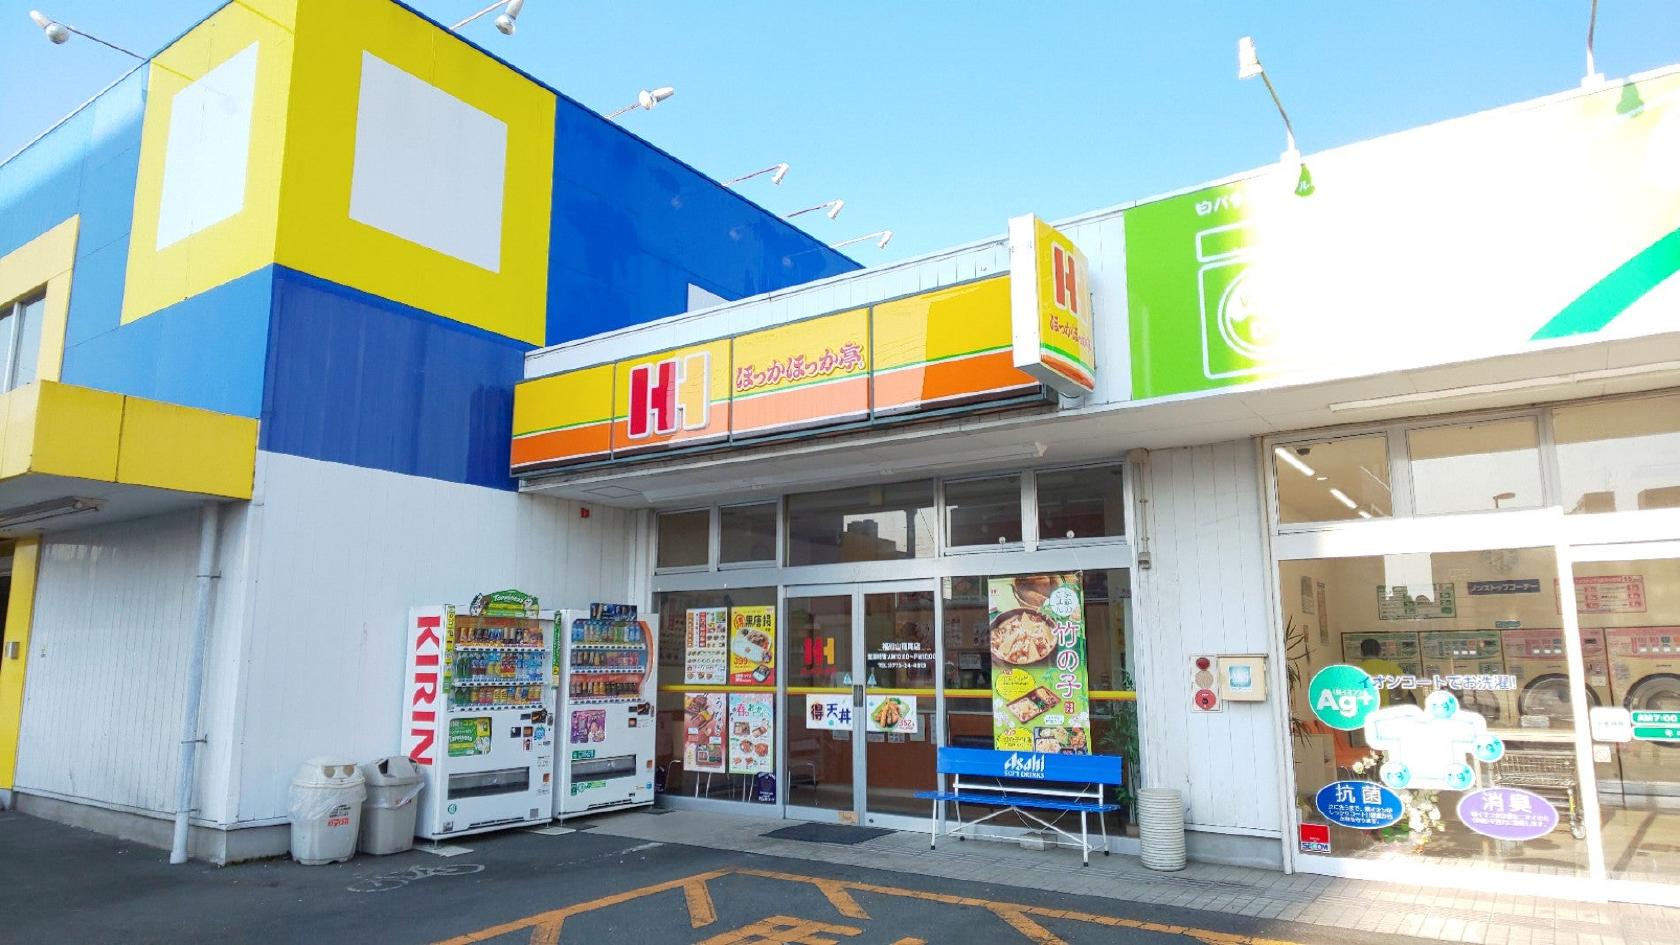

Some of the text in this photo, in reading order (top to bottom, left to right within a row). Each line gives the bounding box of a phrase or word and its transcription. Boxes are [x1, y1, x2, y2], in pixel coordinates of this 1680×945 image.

[736, 342, 866, 391] ほっかほっか亭
[1053, 621, 1082, 698] 竹の子
[410, 615, 441, 765] KIRIN
[1317, 689, 1374, 718] Ag+
[1004, 752, 1045, 772] Asahi
[1335, 783, 1383, 805] 抗菌
[1481, 791, 1533, 813] 消臭
